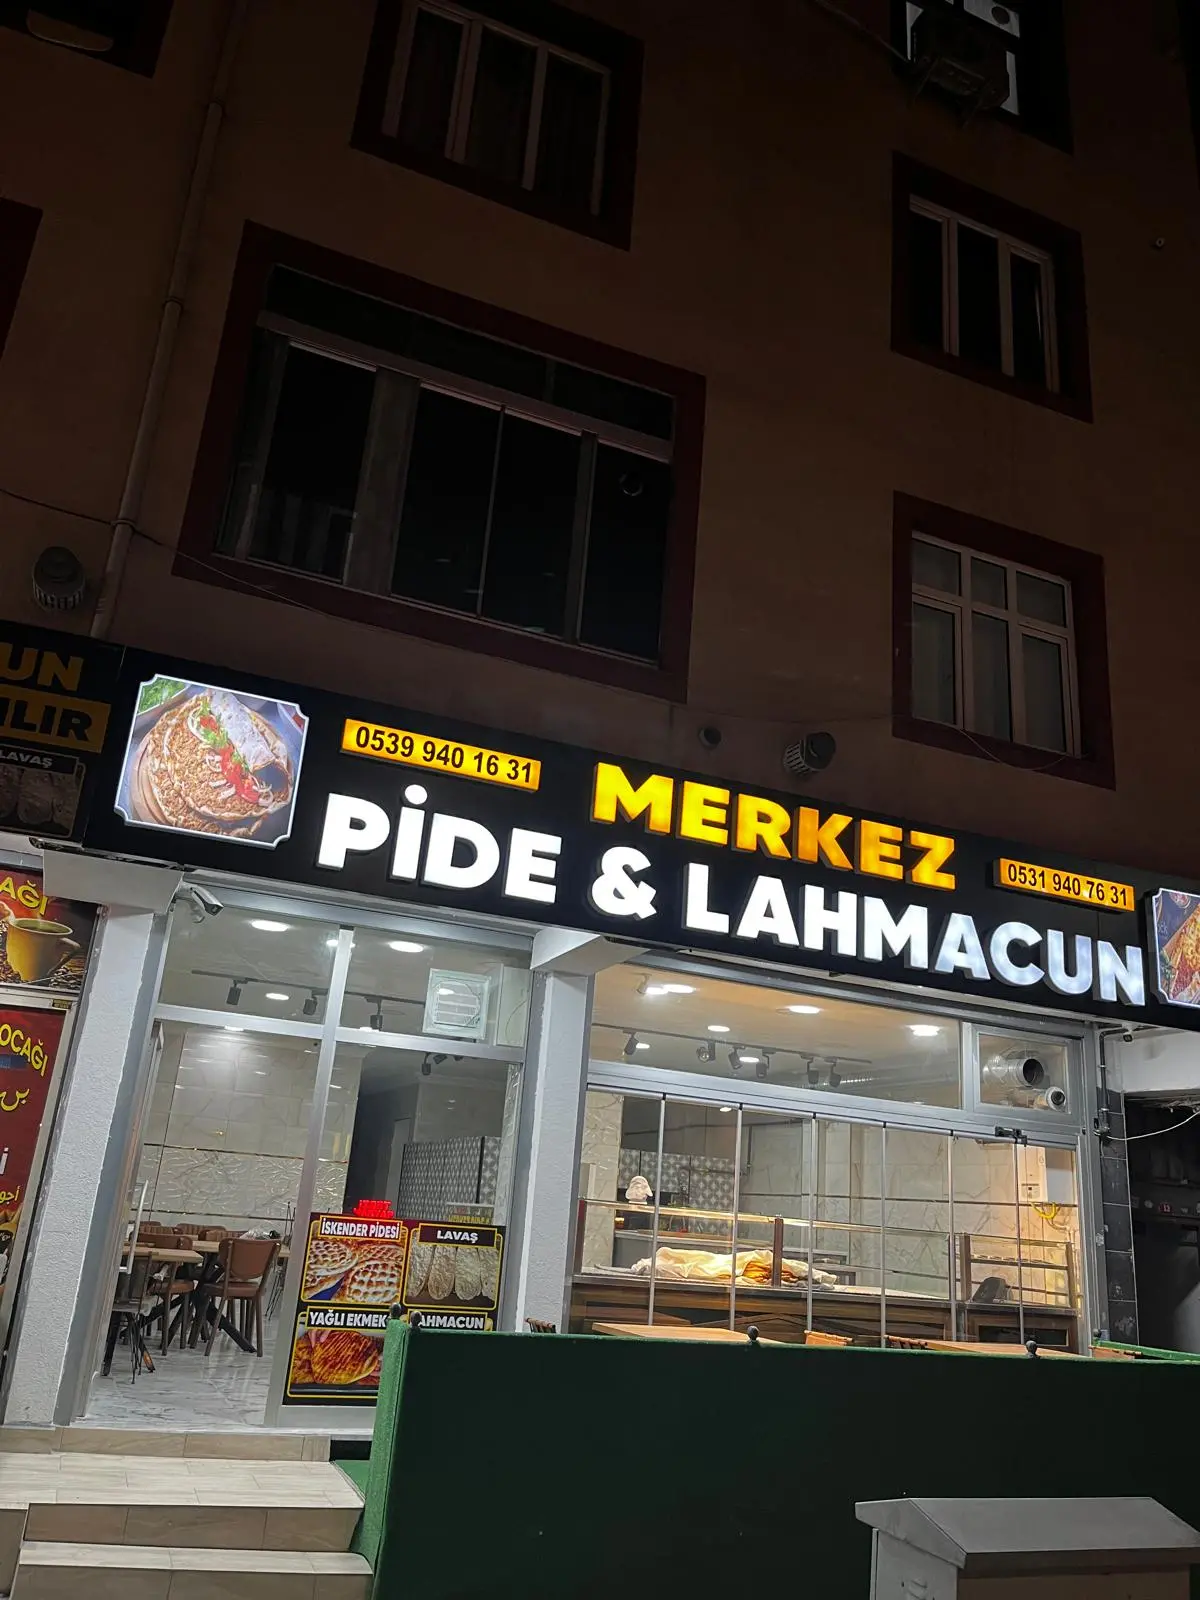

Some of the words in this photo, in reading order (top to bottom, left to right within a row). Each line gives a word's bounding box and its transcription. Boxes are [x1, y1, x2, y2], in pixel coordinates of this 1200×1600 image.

[356, 726, 414, 757] 0539
[422, 741, 464, 769] 940
[473, 752, 499, 776] 16
[506, 759, 531, 783] 31
[593, 762, 956, 891] MERKEZ
[316, 784, 563, 903] PİDE
[591, 846, 657, 921] &
[684, 862, 1146, 1006] LAHMACUN
[1007, 863, 1046, 889] 0531
[1052, 873, 1081, 896] 940
[1086, 881, 1105, 901] 76
[1110, 886, 1127, 906] 31
[321, 1217, 367, 1237] İSKENDER
[368, 1222, 400, 1239] PİDESİ
[436, 1230, 479, 1244] LAVAŞ
[309, 1309, 345, 1327] YAĞLI
[418, 1315, 484, 1329] AHMACUN
